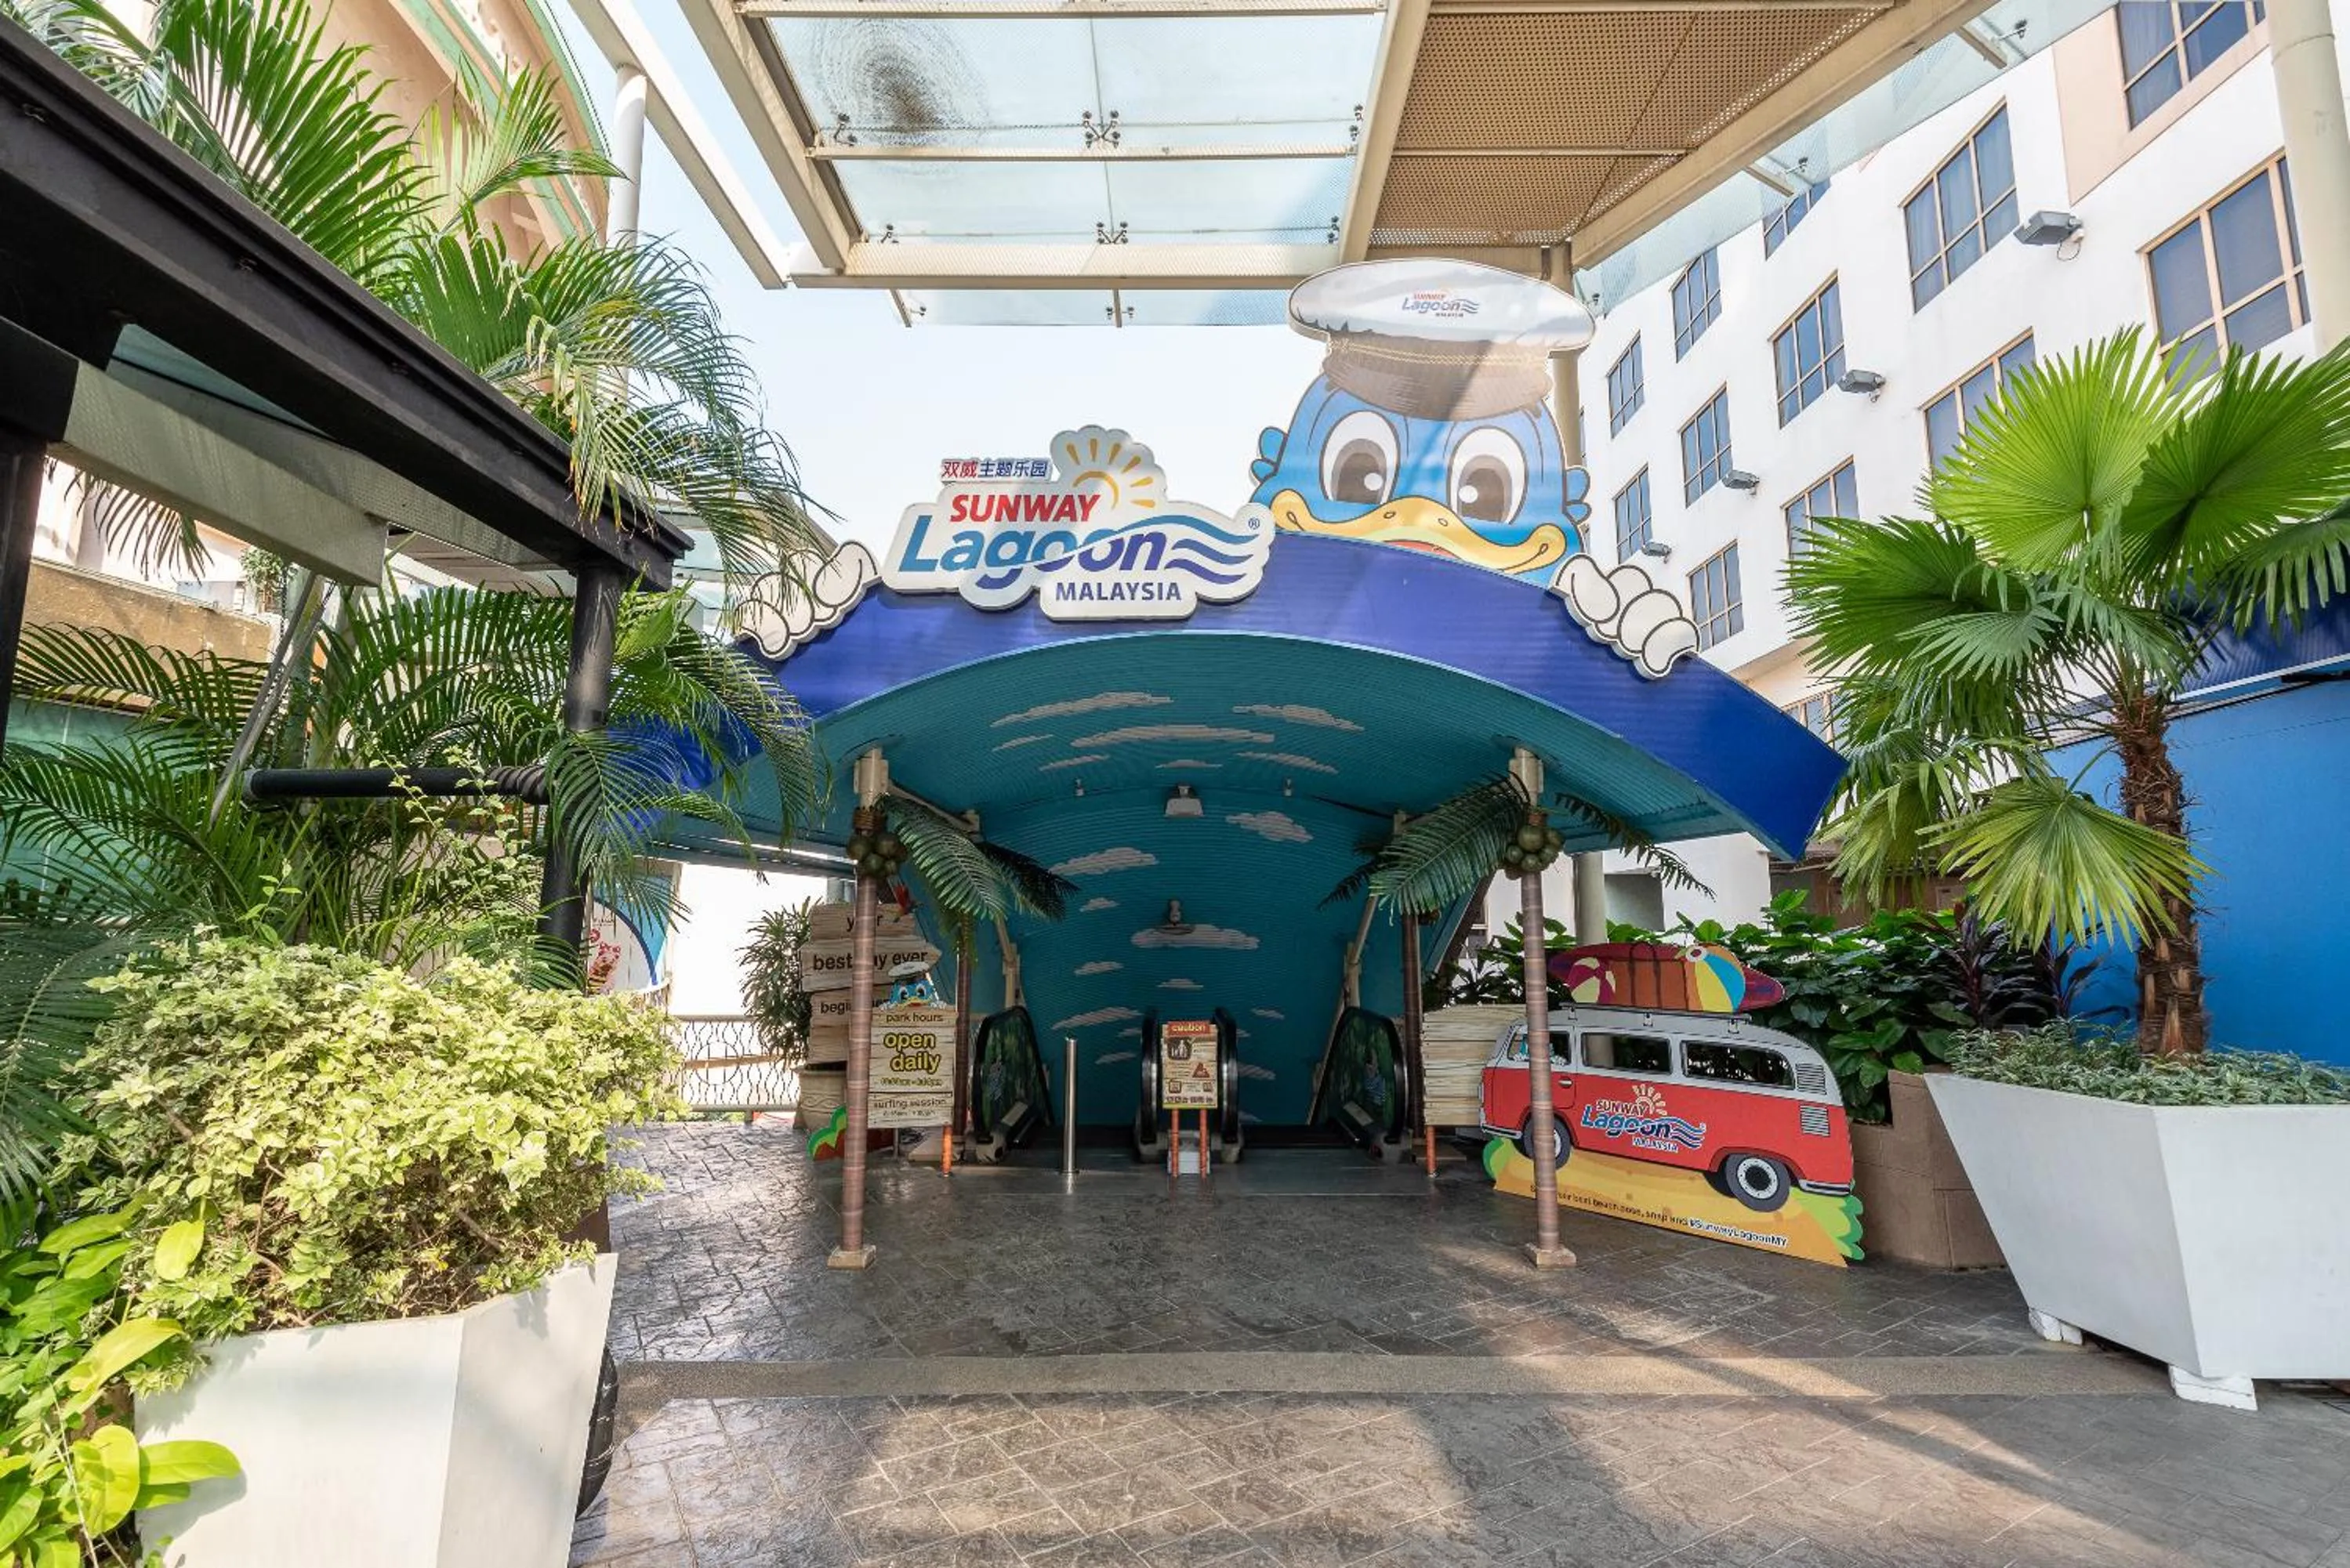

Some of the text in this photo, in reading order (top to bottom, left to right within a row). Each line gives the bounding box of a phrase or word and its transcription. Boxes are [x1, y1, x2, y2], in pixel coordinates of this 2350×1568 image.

[1402, 297, 1460, 313] Lagoon
[941, 459, 1049, 479] 双威主题乐园
[950, 494, 1101, 523] SUNWAY
[898, 514, 1167, 590] Lagoon
[1055, 581, 1182, 602] MALAYSIA
[813, 953, 853, 971] best
[892, 951, 929, 964] ever
[886, 1012, 944, 1023] park hours
[883, 1032, 937, 1053] open
[890, 1051, 941, 1074] daily
[873, 1099, 908, 1110] surfing
[1597, 1099, 1647, 1117] SUNWAY
[1581, 1104, 1671, 1138] Lagoon
